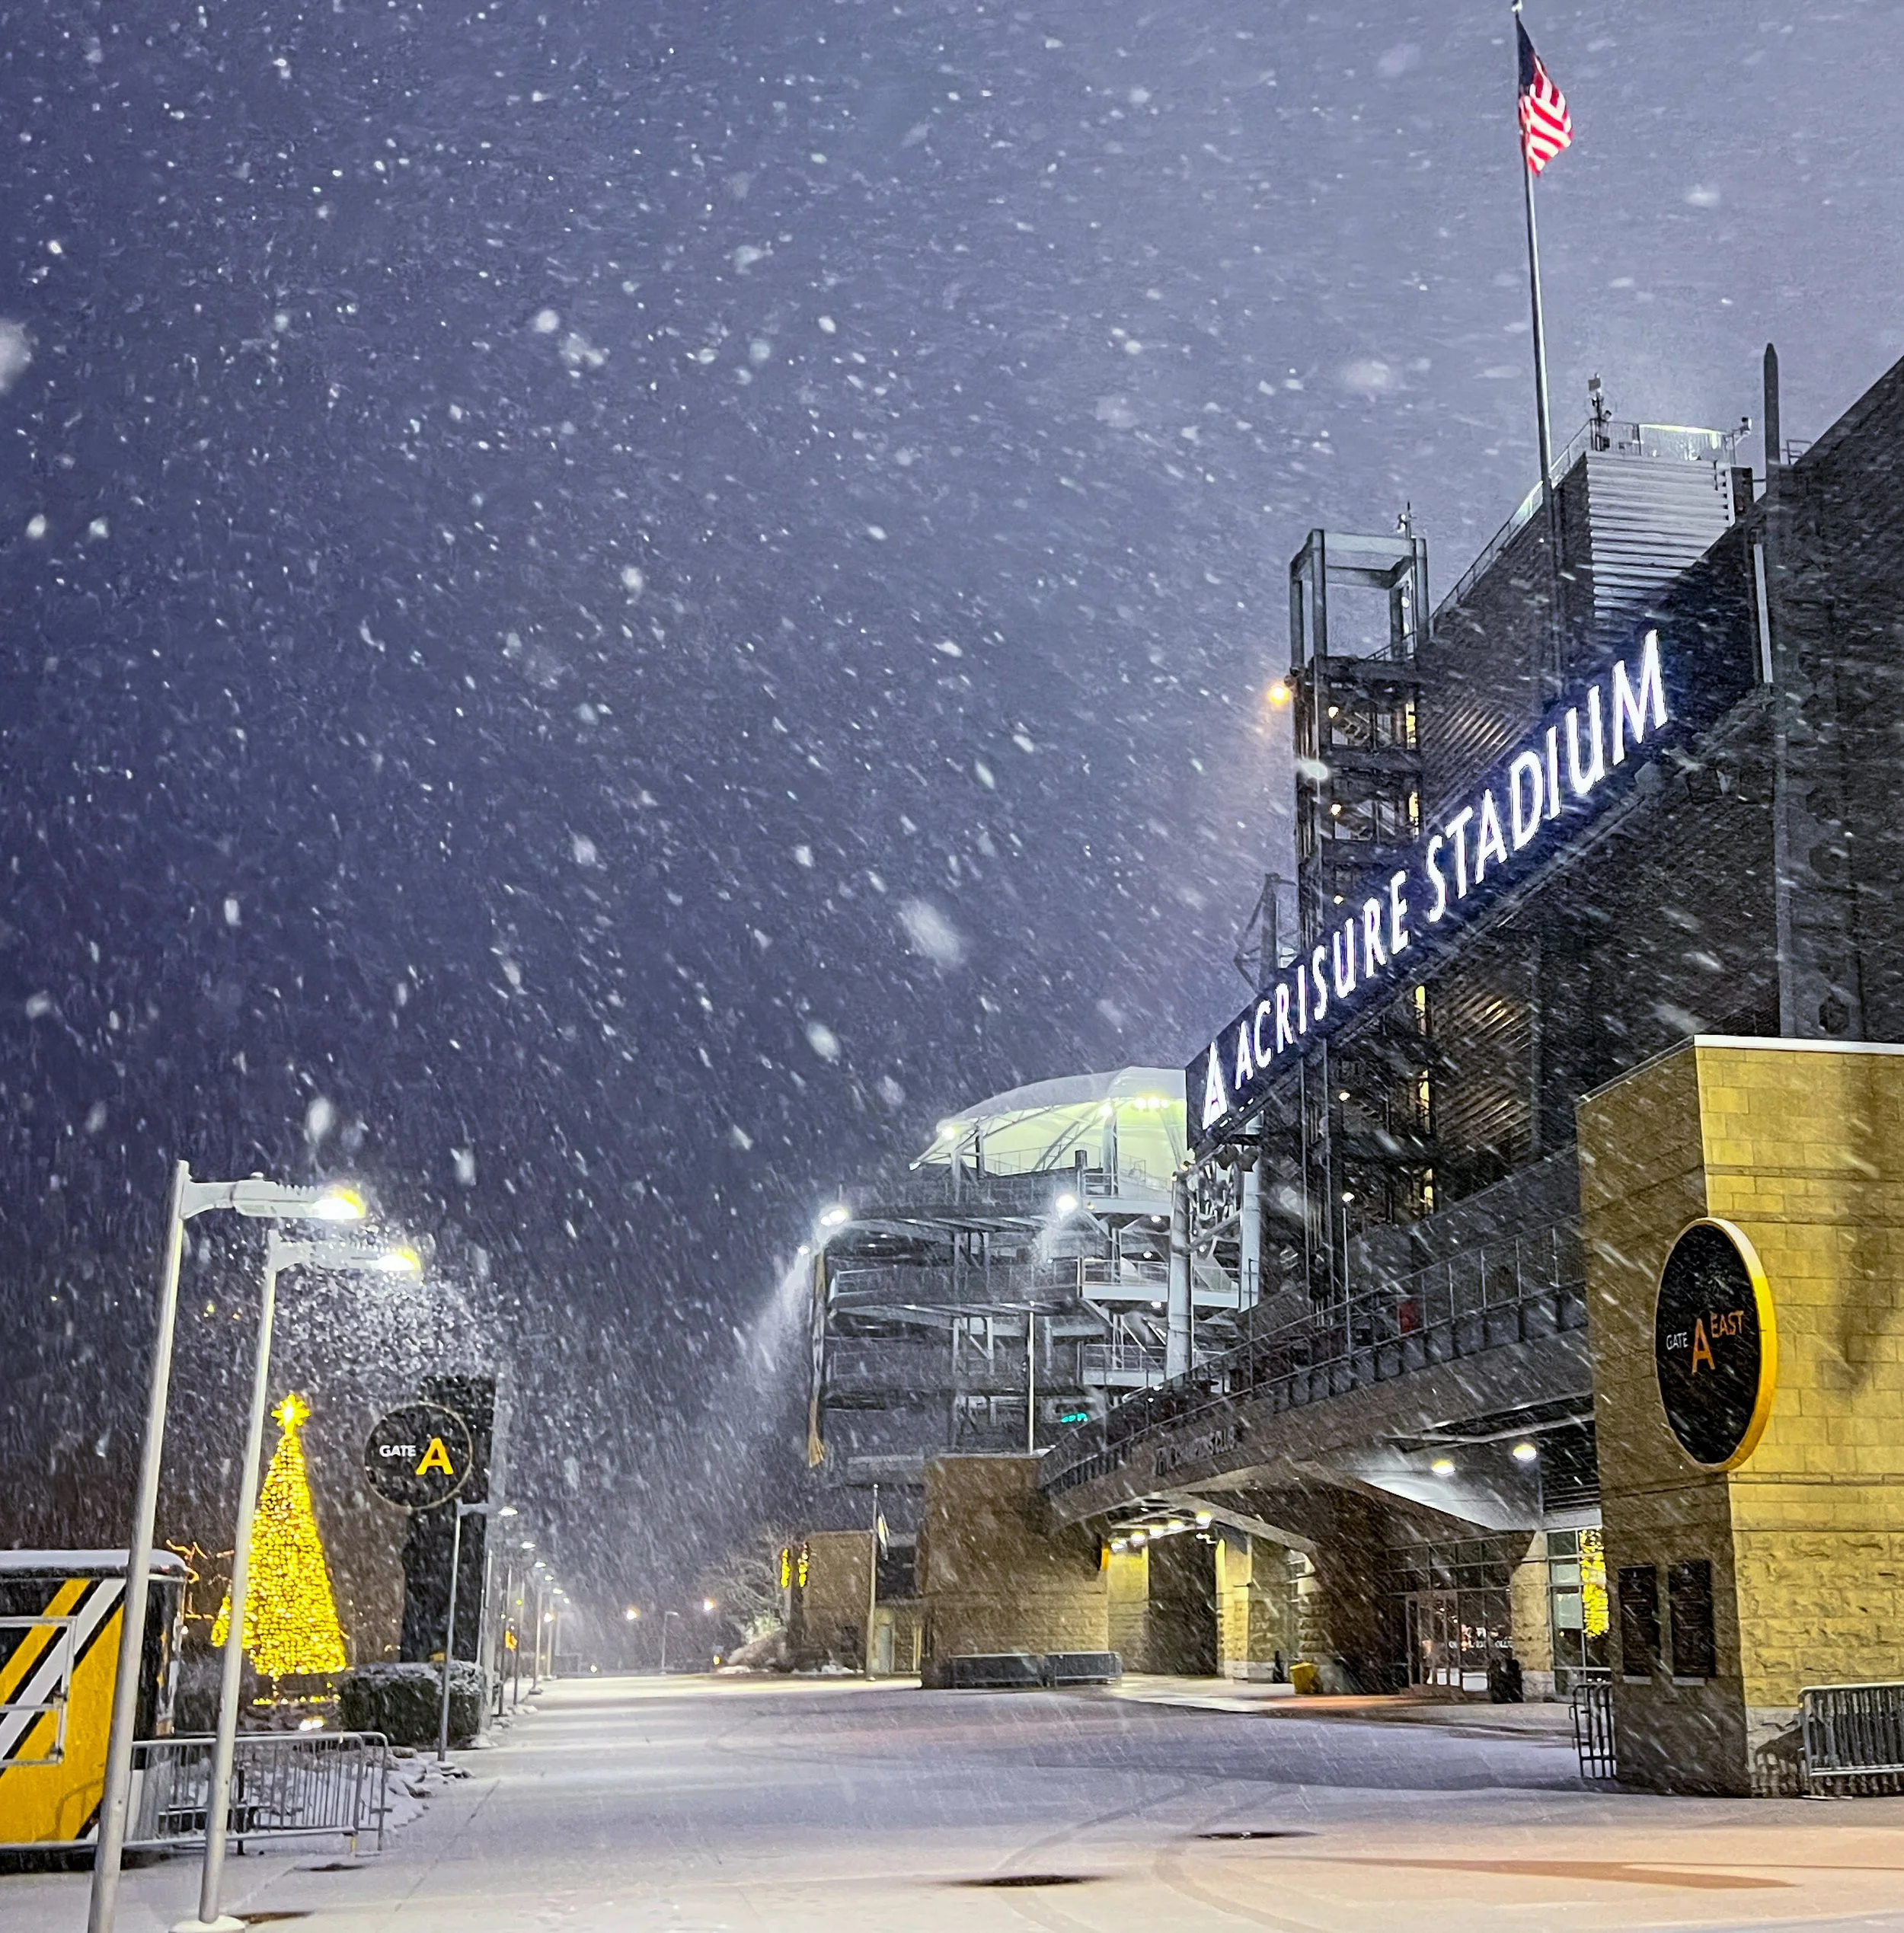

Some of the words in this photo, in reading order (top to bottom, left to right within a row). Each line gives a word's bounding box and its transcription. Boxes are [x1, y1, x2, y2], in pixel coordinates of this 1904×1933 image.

[1235, 870, 1409, 1090] ACRISURE
[1426, 629, 1668, 923] STADIUM
[1666, 1332, 1688, 1350] GATE
[1692, 1318, 1715, 1372] A
[1711, 1311, 1745, 1338] EAST
[379, 1445, 417, 1458] GATE
[415, 1438, 455, 1475] A
